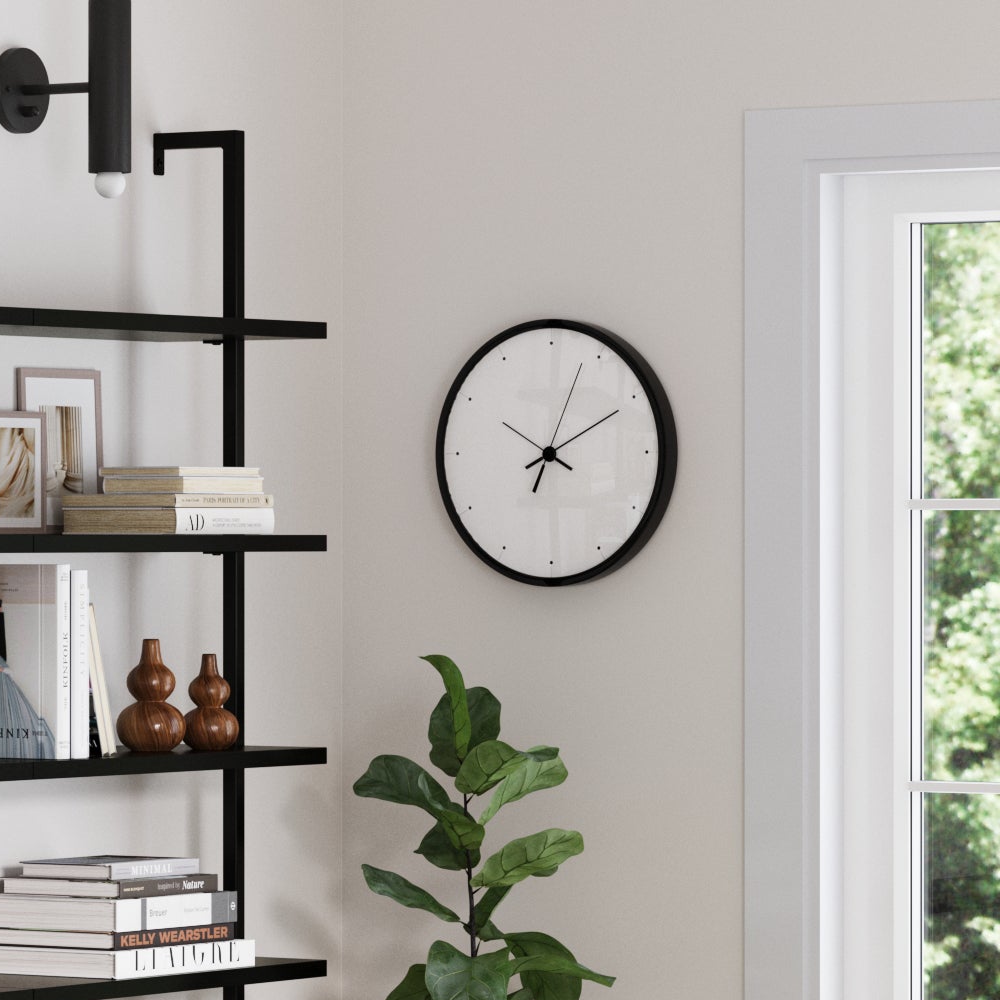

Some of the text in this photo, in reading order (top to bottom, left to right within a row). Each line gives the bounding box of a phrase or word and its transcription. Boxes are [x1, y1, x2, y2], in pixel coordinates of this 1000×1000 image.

[130, 863, 173, 876] MINIMAL
[182, 880, 205, 890] Nature
[120, 926, 228, 947] KELLY WEARSTLER
